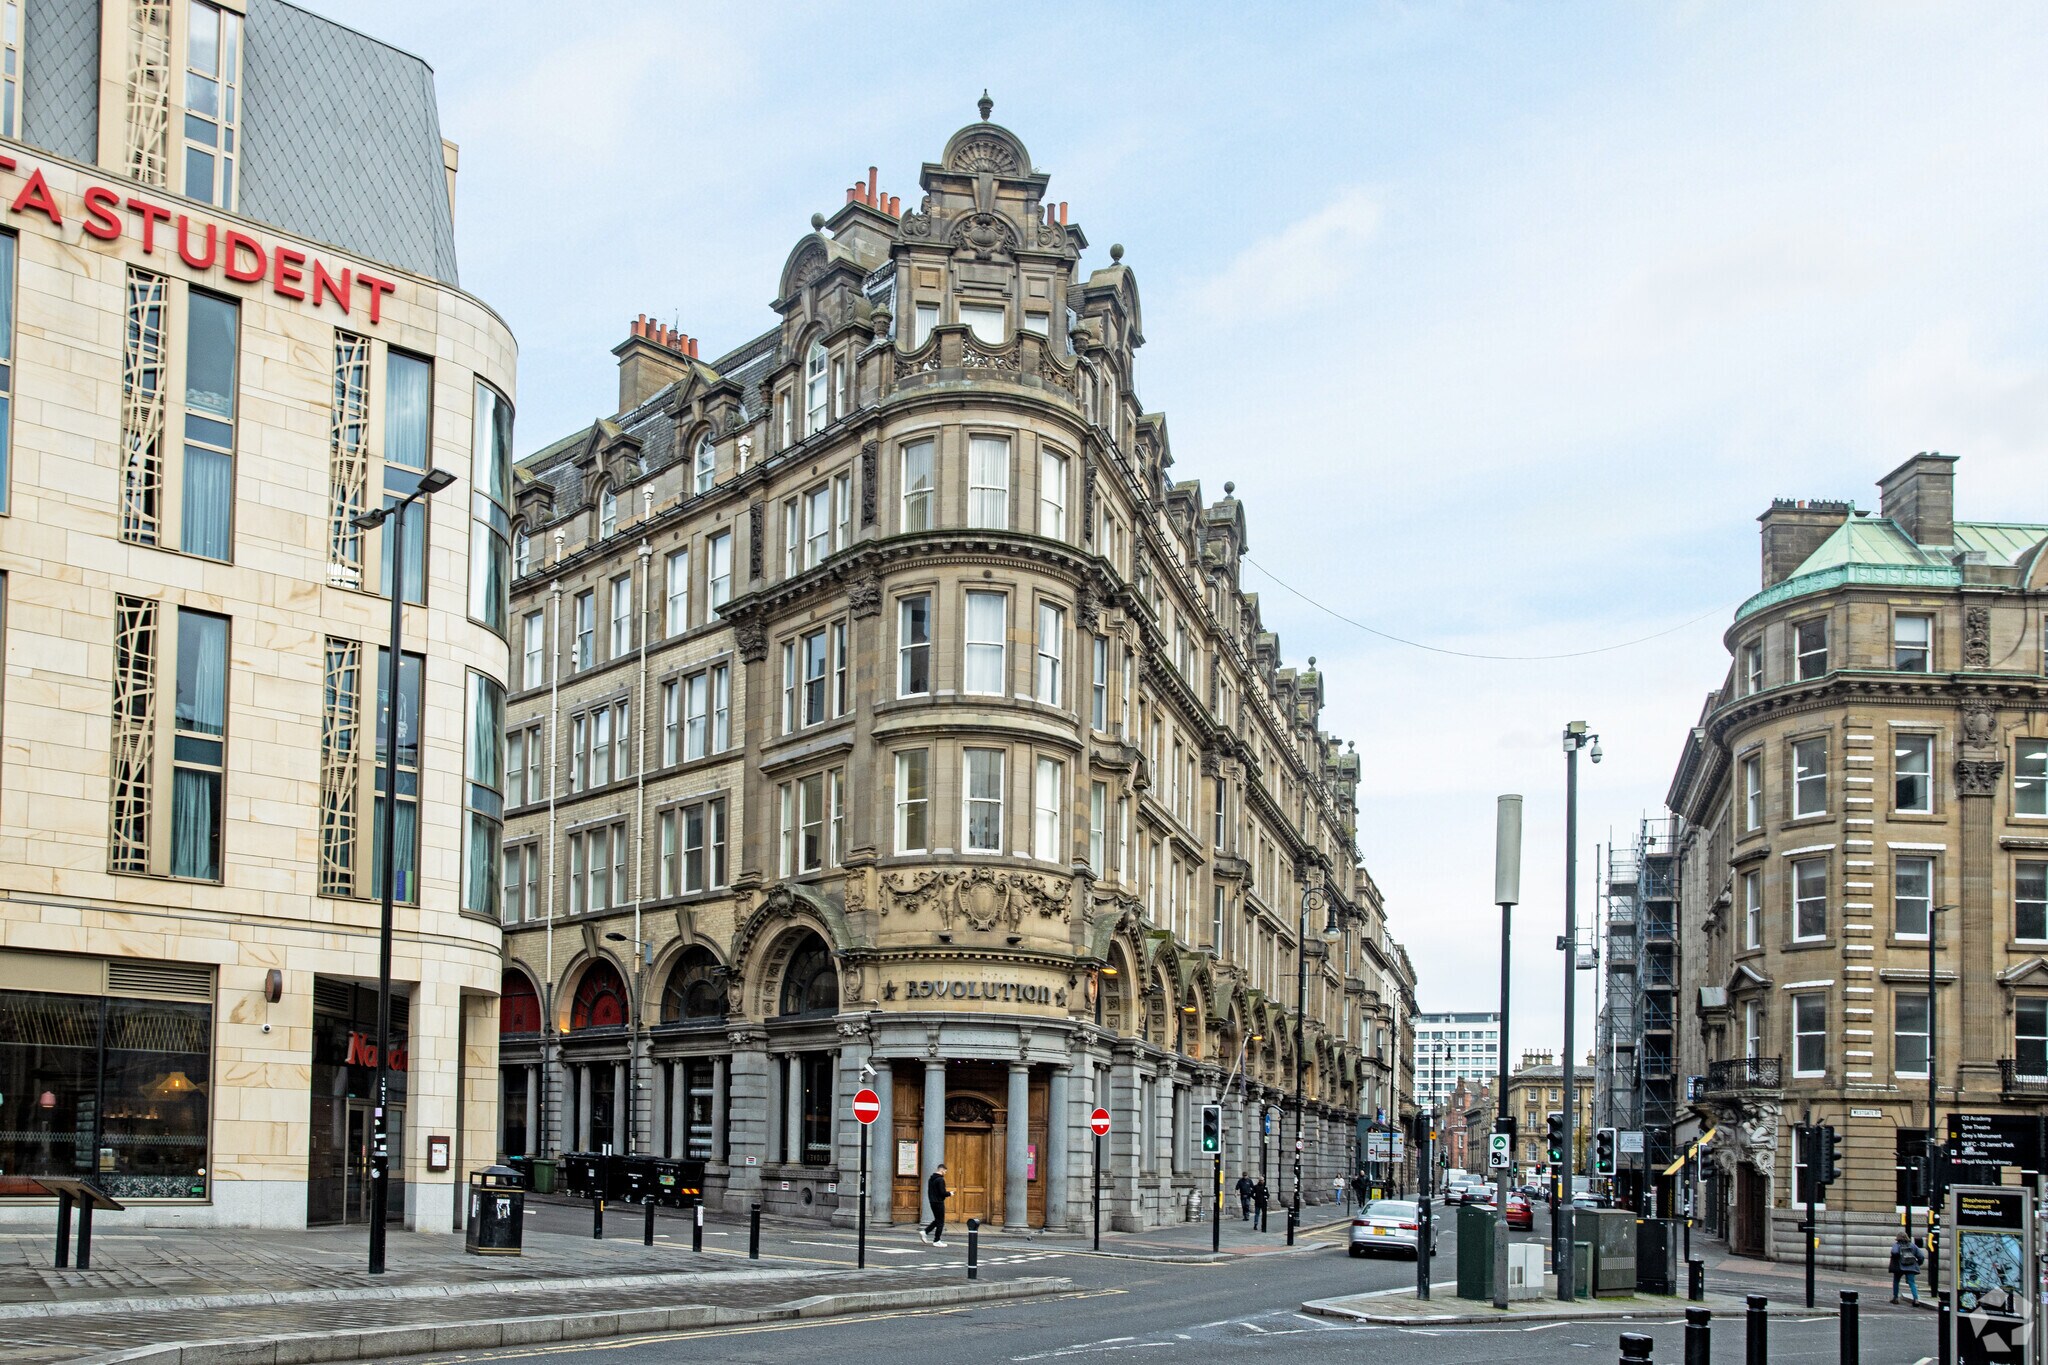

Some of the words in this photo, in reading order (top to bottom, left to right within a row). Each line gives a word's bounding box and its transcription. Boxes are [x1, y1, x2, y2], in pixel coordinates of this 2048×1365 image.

[0, 155, 63, 228] A
[82, 186, 396, 325] STUDENT
[905, 980, 1052, 1005] REVOLUTION
